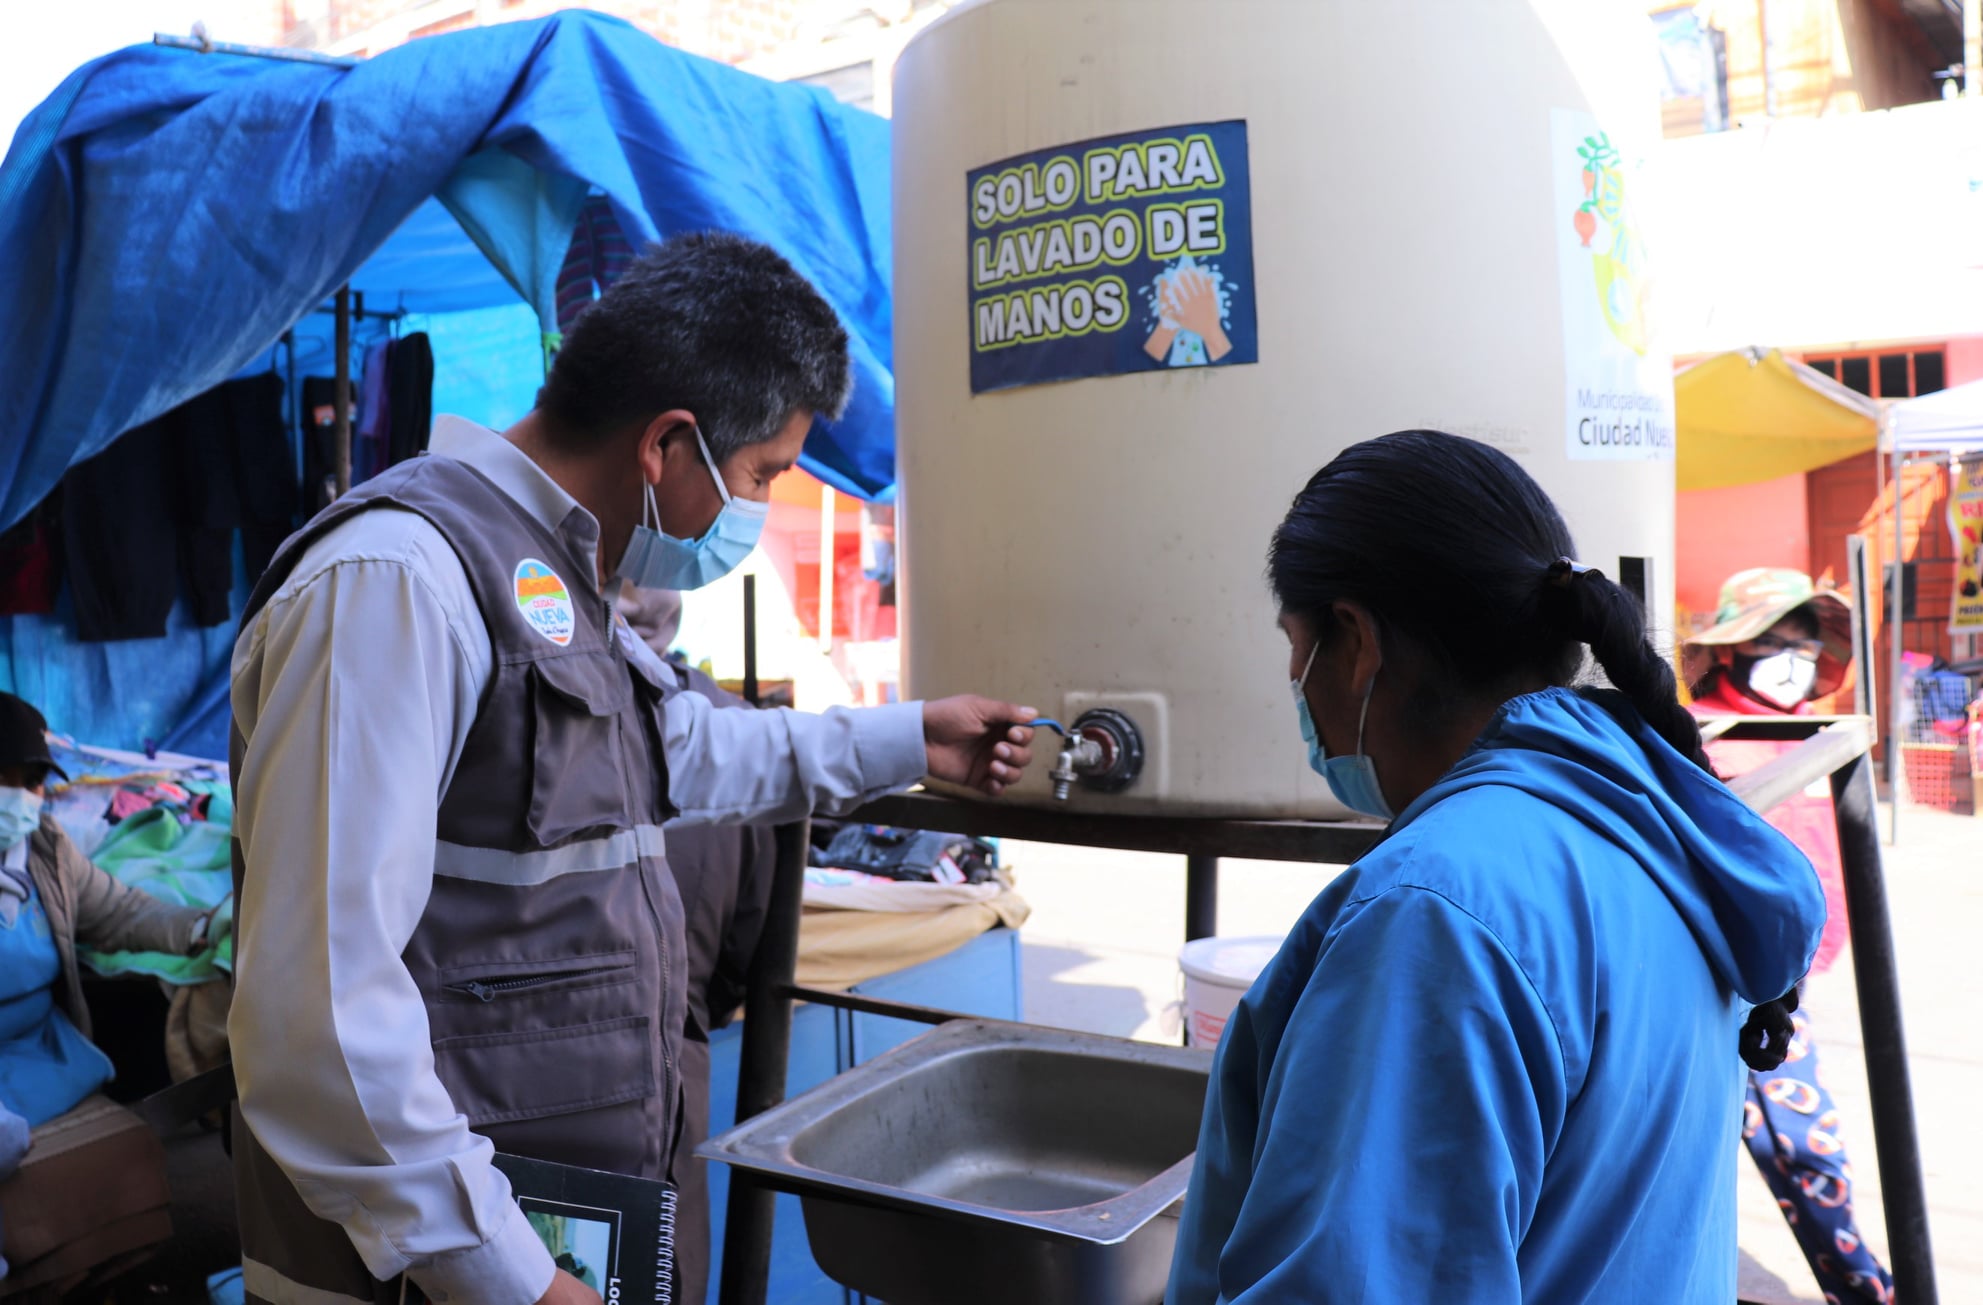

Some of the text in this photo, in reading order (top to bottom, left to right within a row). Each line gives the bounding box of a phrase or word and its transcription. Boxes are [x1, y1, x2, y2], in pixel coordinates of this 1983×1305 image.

[975, 138, 1220, 224] SOLO PARA
[976, 203, 1221, 285] LAVADO DE
[977, 280, 1125, 346] MANOS
[1578, 416, 1673, 448] Ciudad Nue
[528, 608, 570, 625] NUEVA
